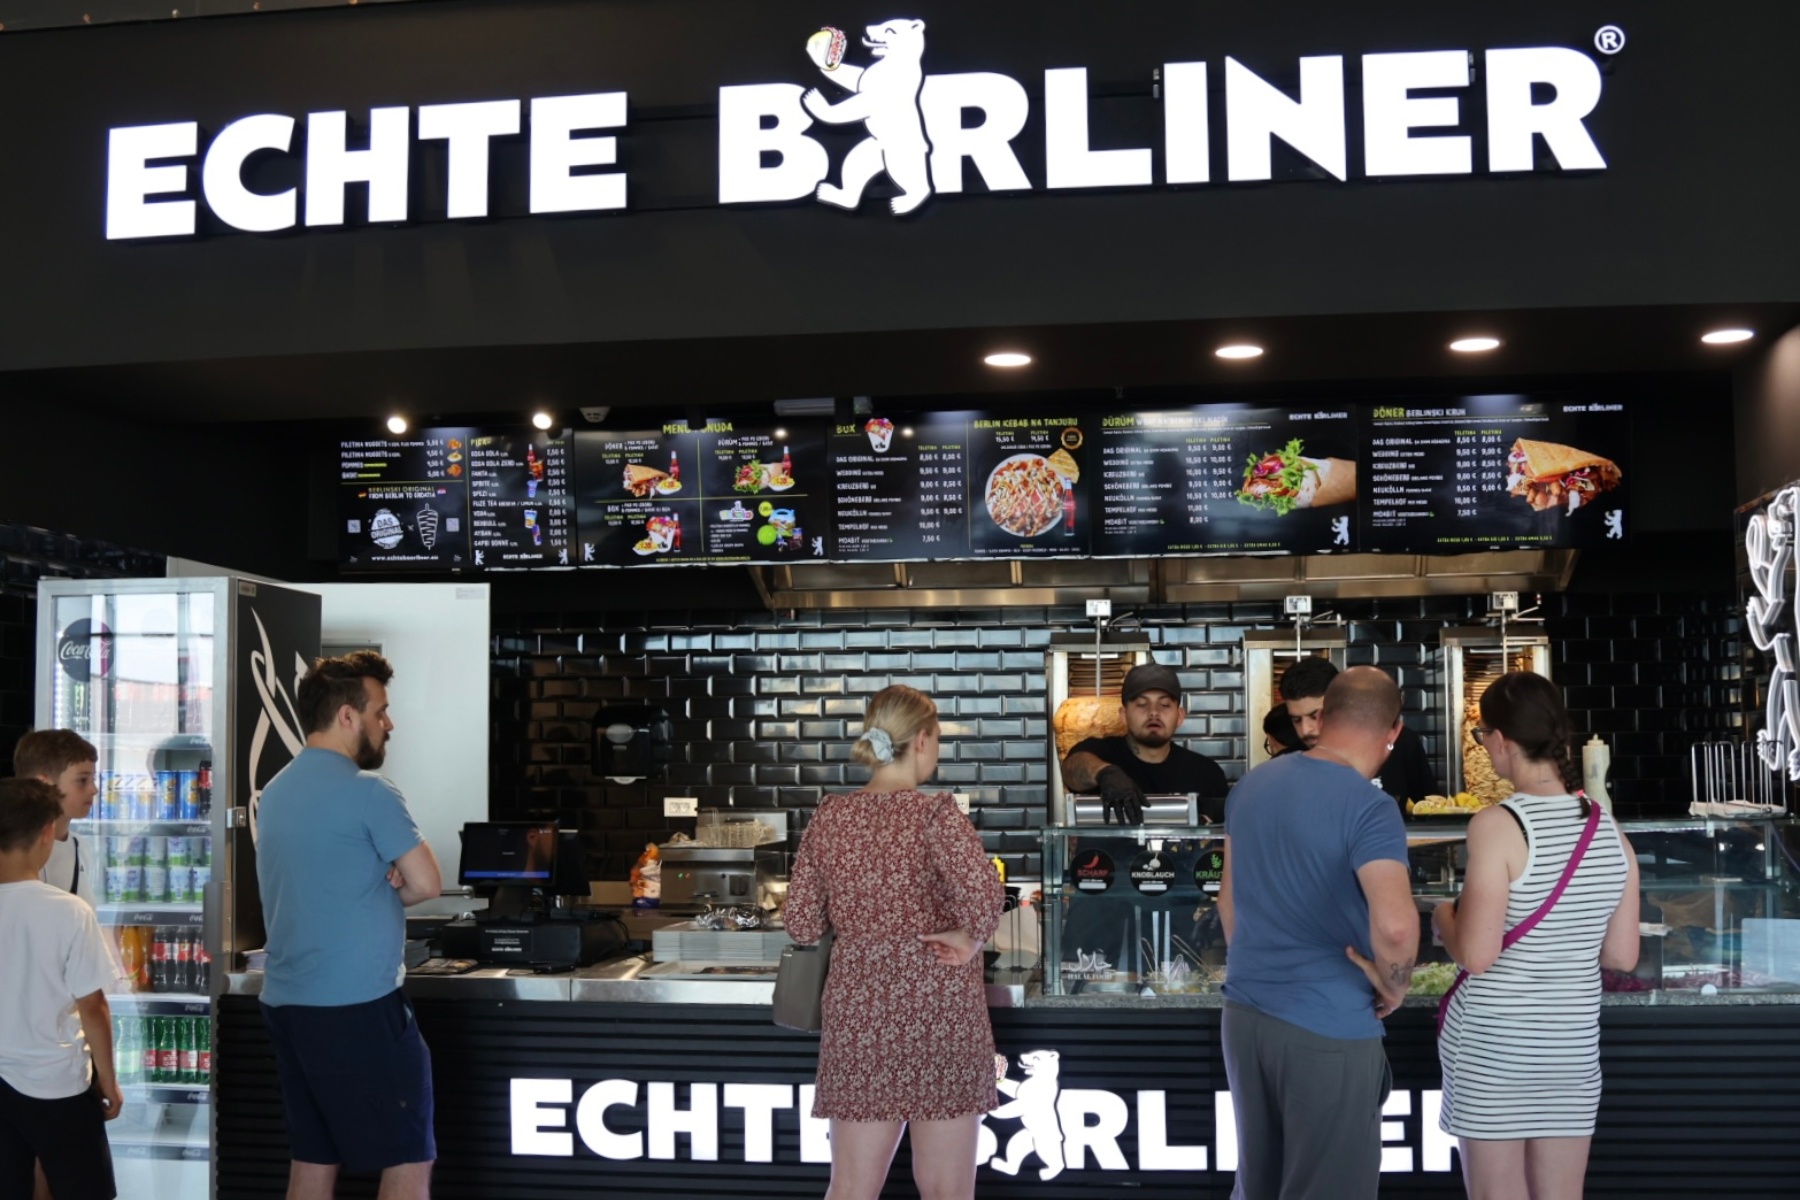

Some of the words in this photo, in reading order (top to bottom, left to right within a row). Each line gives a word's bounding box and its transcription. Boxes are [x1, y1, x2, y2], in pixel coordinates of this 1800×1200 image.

[106, 92, 628, 240] ECHTE
[1373, 406, 1405, 418] DÖNER
[1406, 409, 1444, 417] BERLINSKI
[1446, 408, 1467, 416] KRUH
[974, 420, 1000, 428] BERLIN
[1003, 419, 1028, 428] KEBAB
[1030, 419, 1042, 427] NA
[1102, 416, 1134, 427] DÜRÜM
[1385, 438, 1413, 446] ORIGINAL
[376, 517, 394, 528] DAS
[371, 526, 402, 538] ORIGINAL
[1077, 869, 1109, 878] SCHARF
[1131, 871, 1175, 879] KNOBLAUCH
